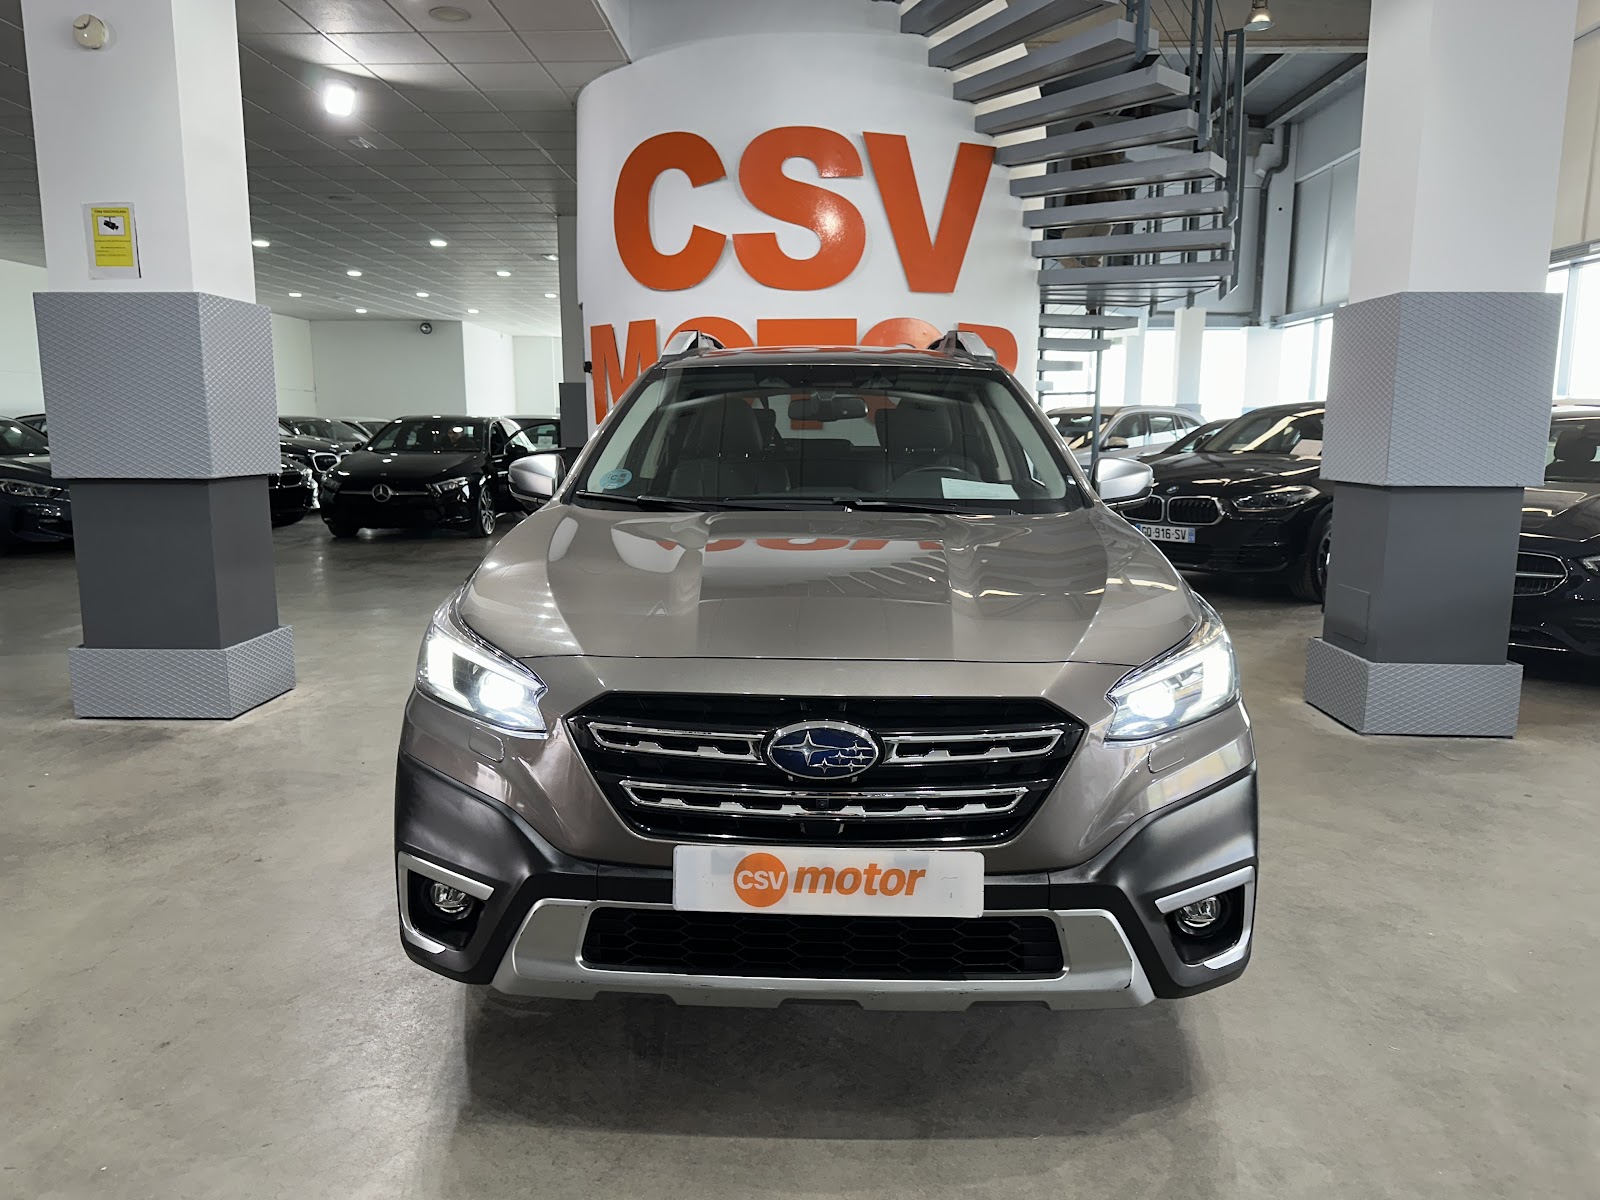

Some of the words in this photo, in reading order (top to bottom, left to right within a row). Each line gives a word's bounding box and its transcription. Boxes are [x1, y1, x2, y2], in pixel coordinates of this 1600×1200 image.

[613, 125, 996, 294] CSV
[737, 870, 786, 890] CSV
[793, 863, 926, 896] motor
